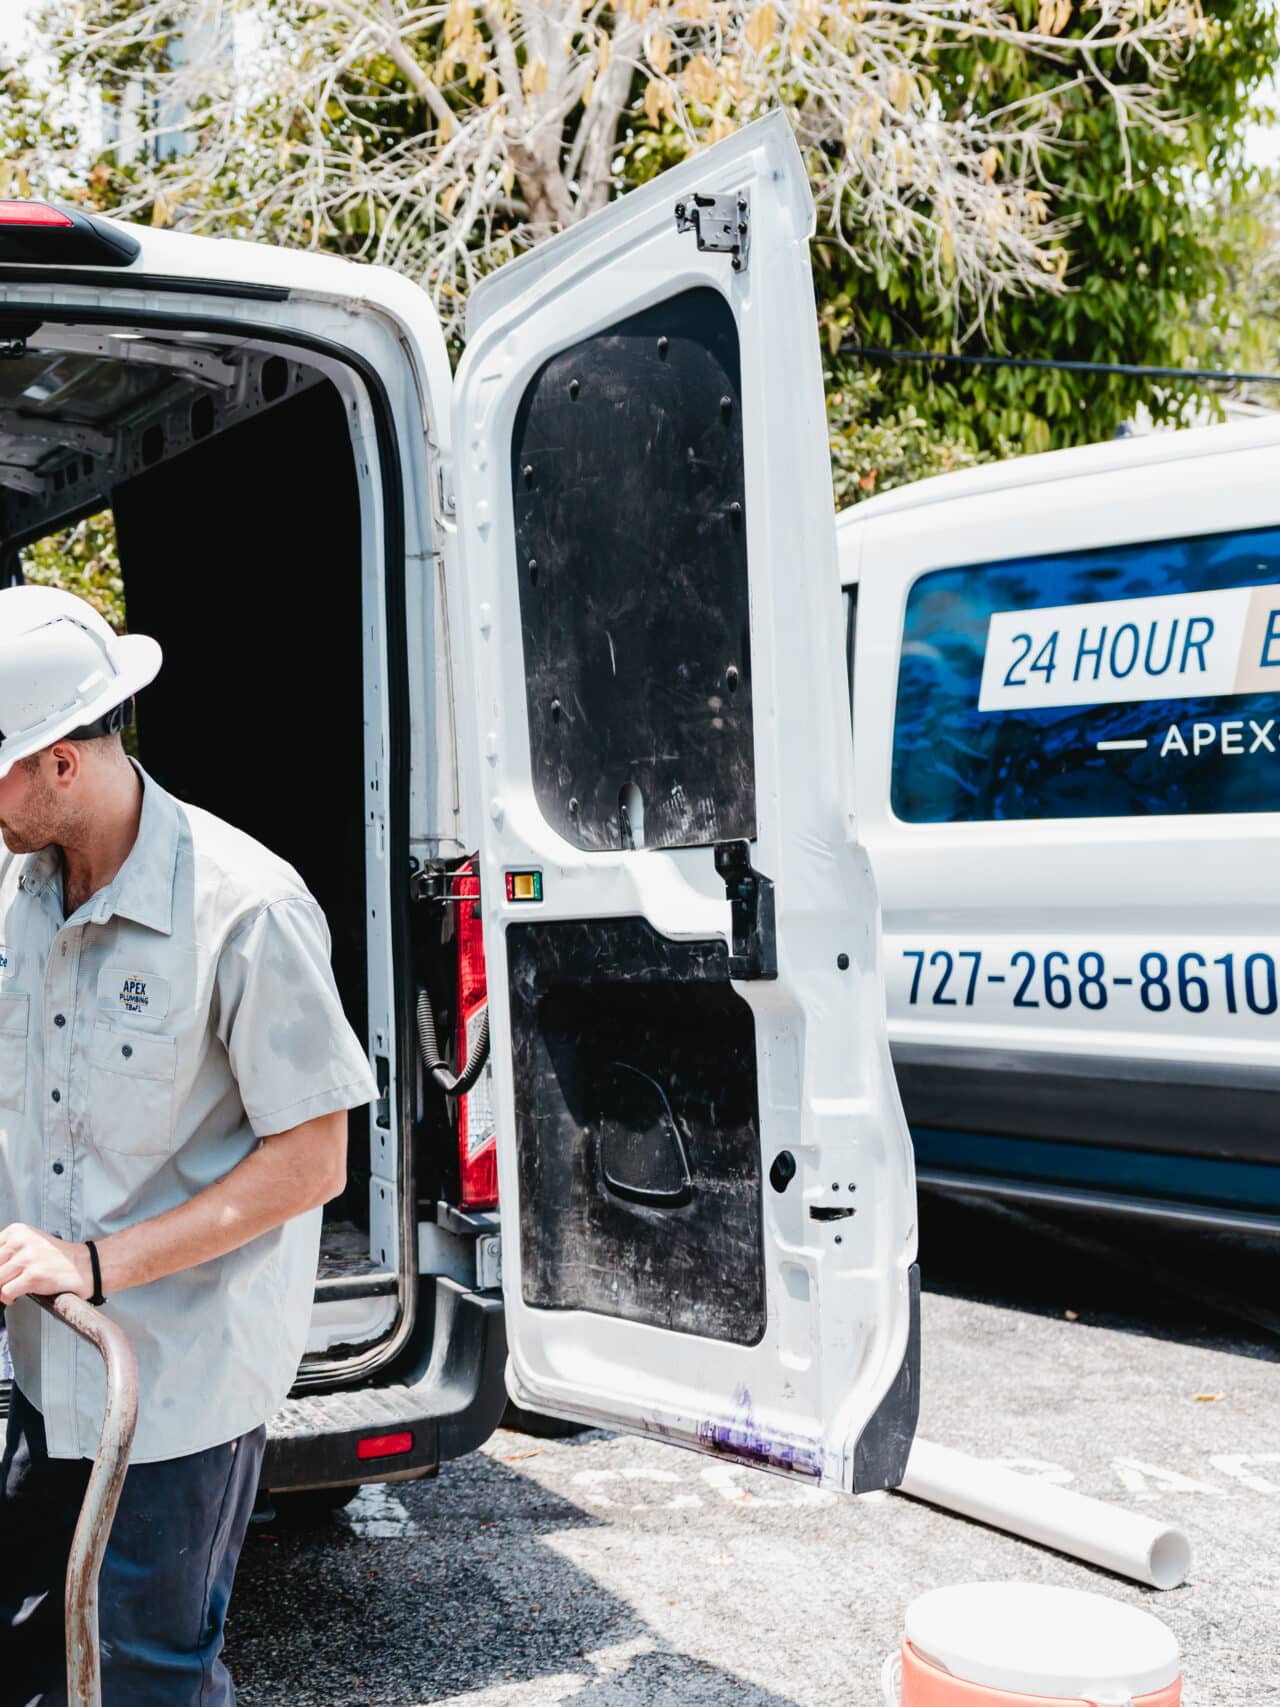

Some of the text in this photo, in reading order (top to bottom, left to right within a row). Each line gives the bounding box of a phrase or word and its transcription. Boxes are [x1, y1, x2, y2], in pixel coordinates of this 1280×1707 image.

[1004, 630, 1059, 686] 24
[1073, 617, 1214, 681] HOUR
[120, 993, 149, 1005] PLUMBING
[123, 980, 146, 995] APEX
[903, 950, 1279, 1015] 727-268-8610
